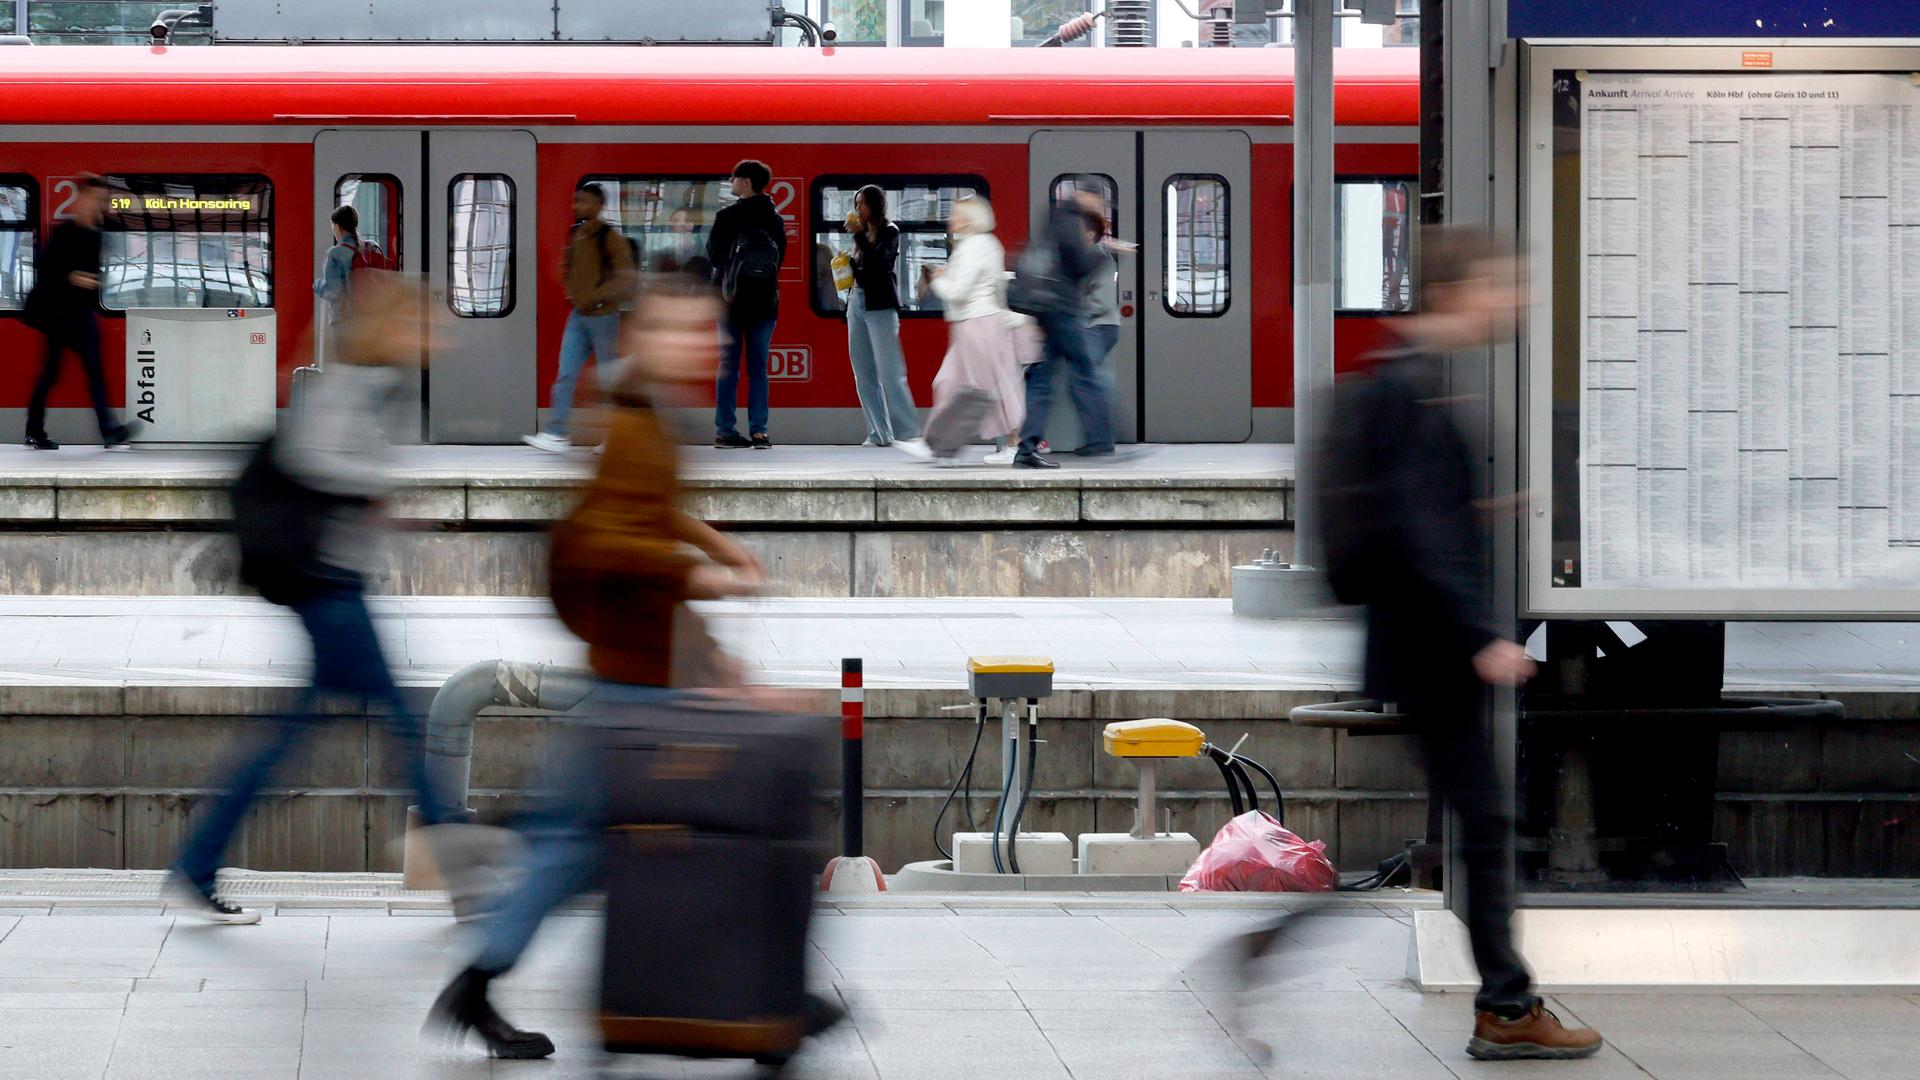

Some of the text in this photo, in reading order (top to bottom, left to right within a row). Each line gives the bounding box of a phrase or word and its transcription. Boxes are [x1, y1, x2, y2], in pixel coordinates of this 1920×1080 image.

[1588, 88, 1695, 98] Ankunft Arrival Arrivée
[1706, 90, 1839, 100] Köln Hbf (ohne Gleis 10 und 11)
[54, 181, 79, 219] 2
[180, 198, 250, 210] Hansaring
[770, 181, 796, 221] 2
[251, 334, 265, 343] DB
[768, 350, 807, 377] DB
[137, 350, 155, 424] Abfall
